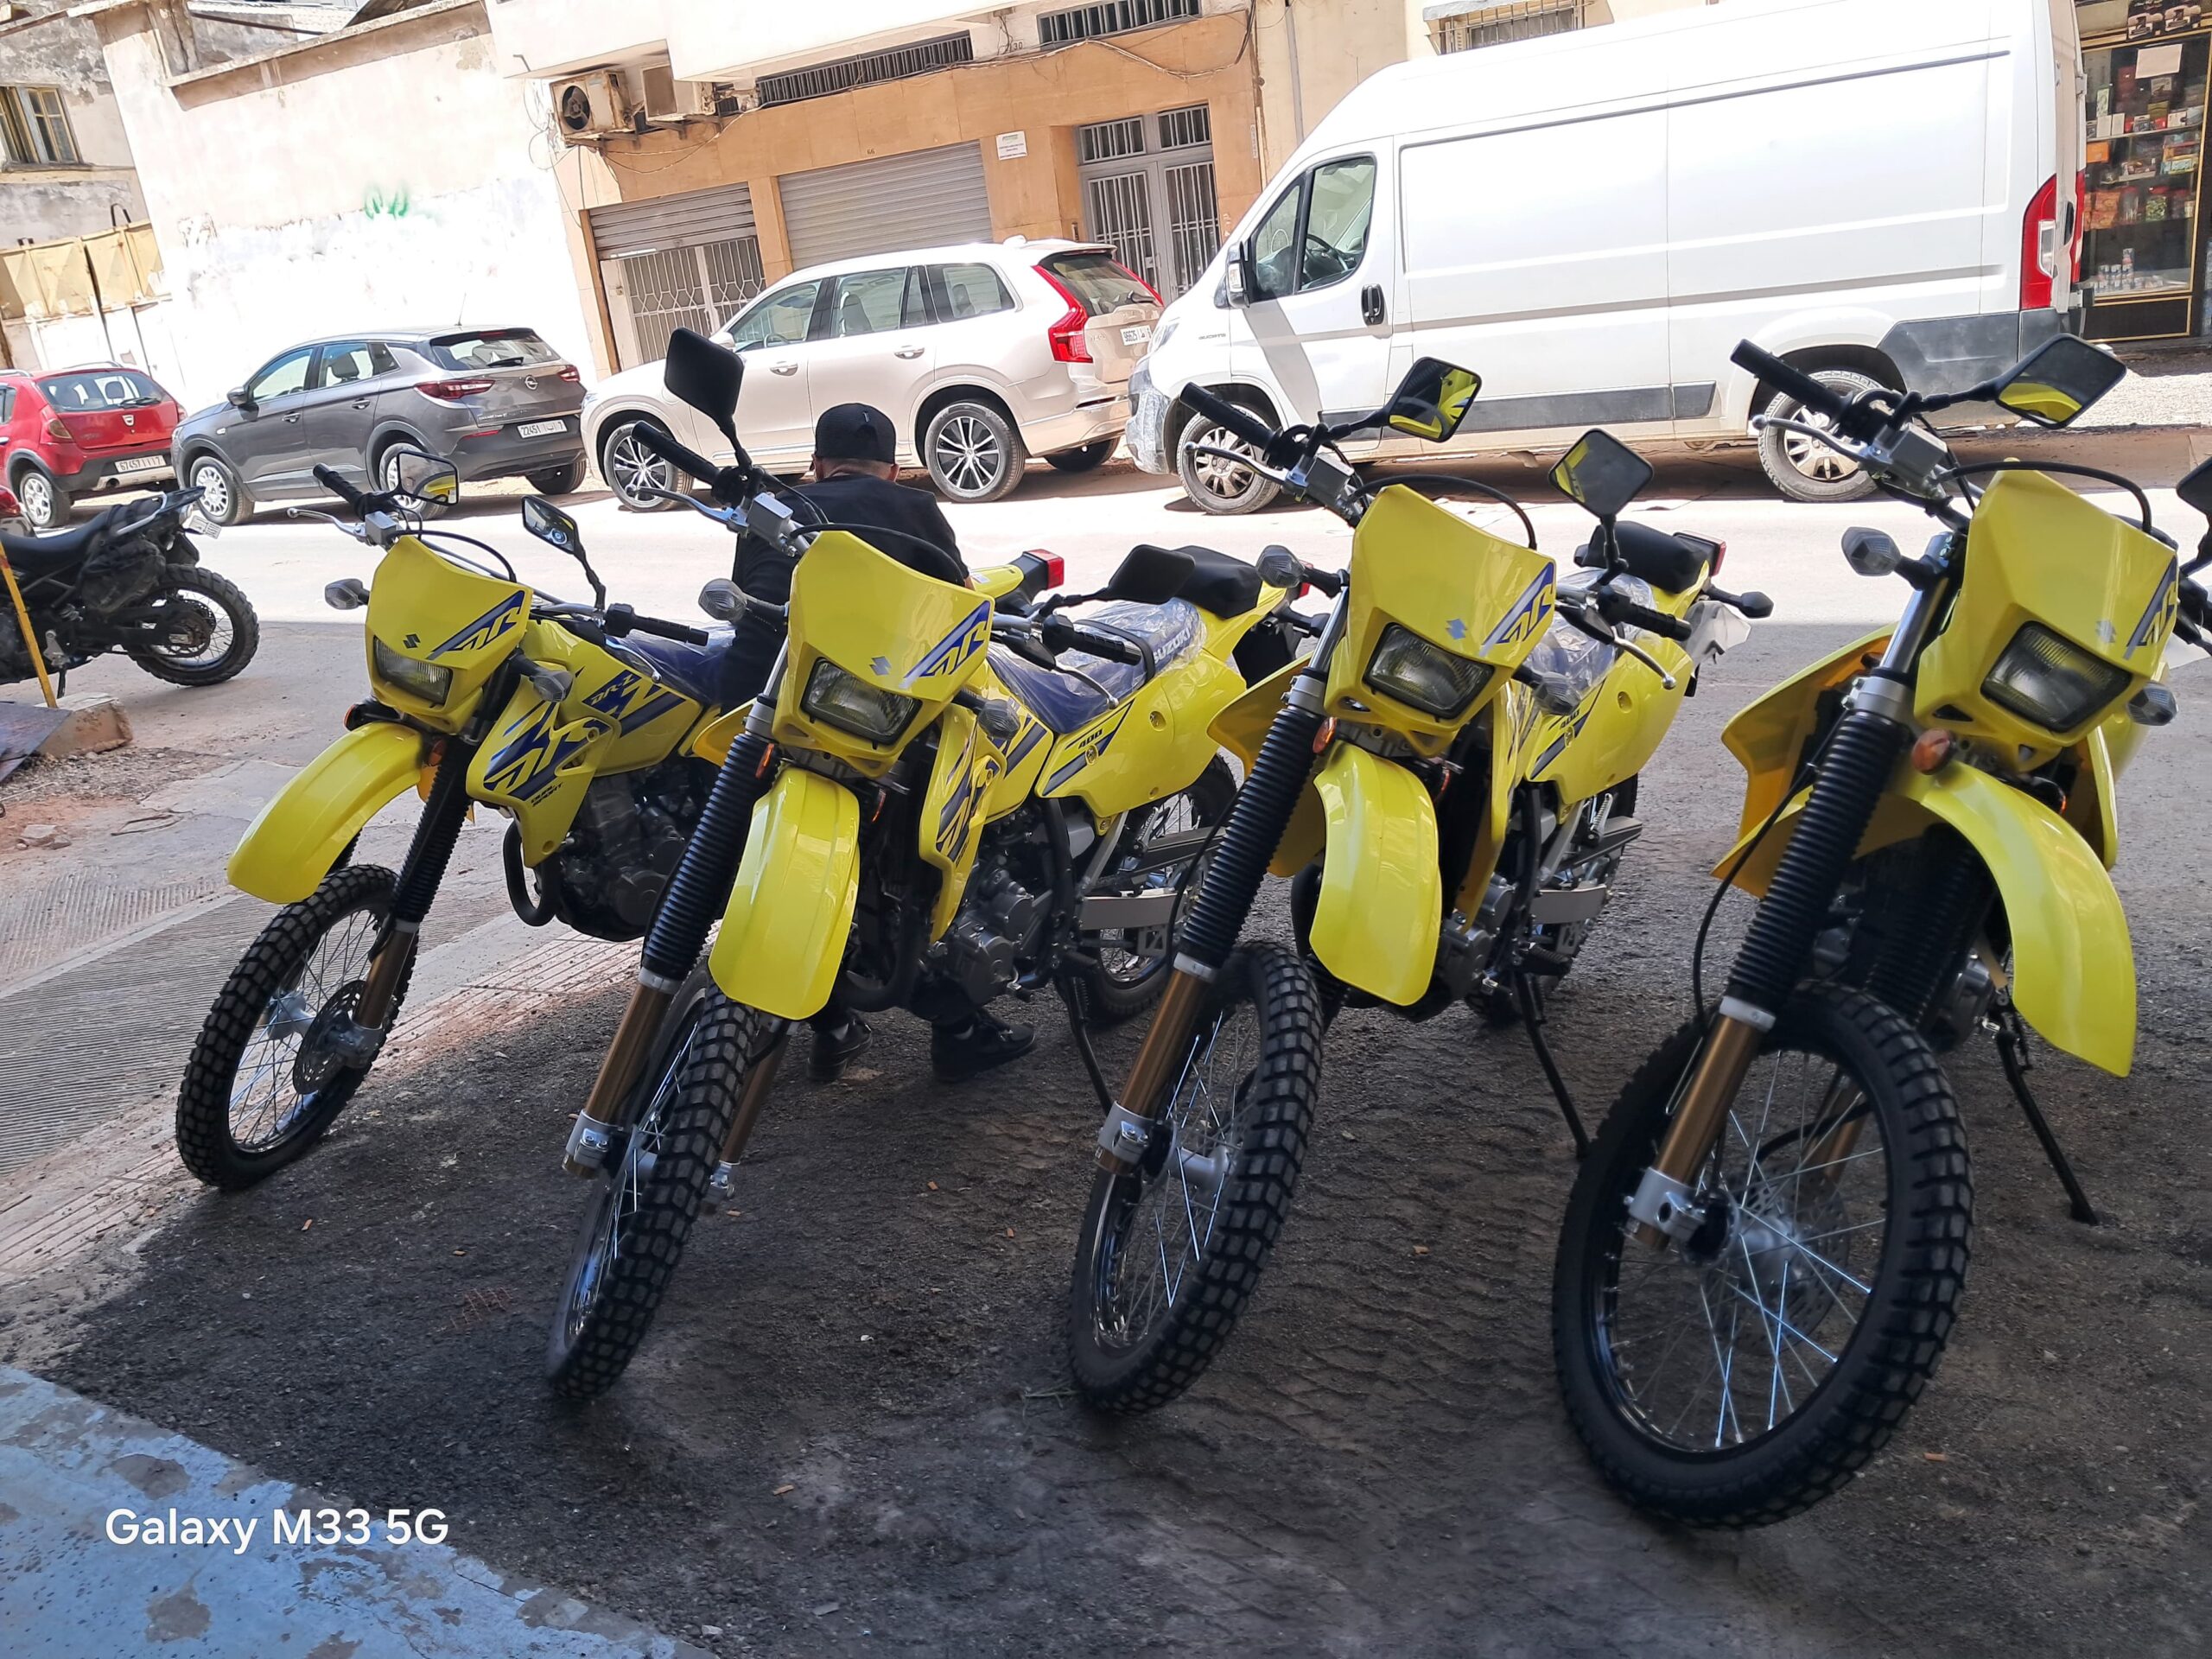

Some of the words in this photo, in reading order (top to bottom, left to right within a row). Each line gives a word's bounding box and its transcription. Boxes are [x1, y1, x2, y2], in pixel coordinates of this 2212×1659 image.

[520, 425, 541, 436] 22451
[1153, 627, 1191, 664] SUZUKI
[590, 675, 634, 706] DR-Z
[1077, 728, 1103, 750] 400
